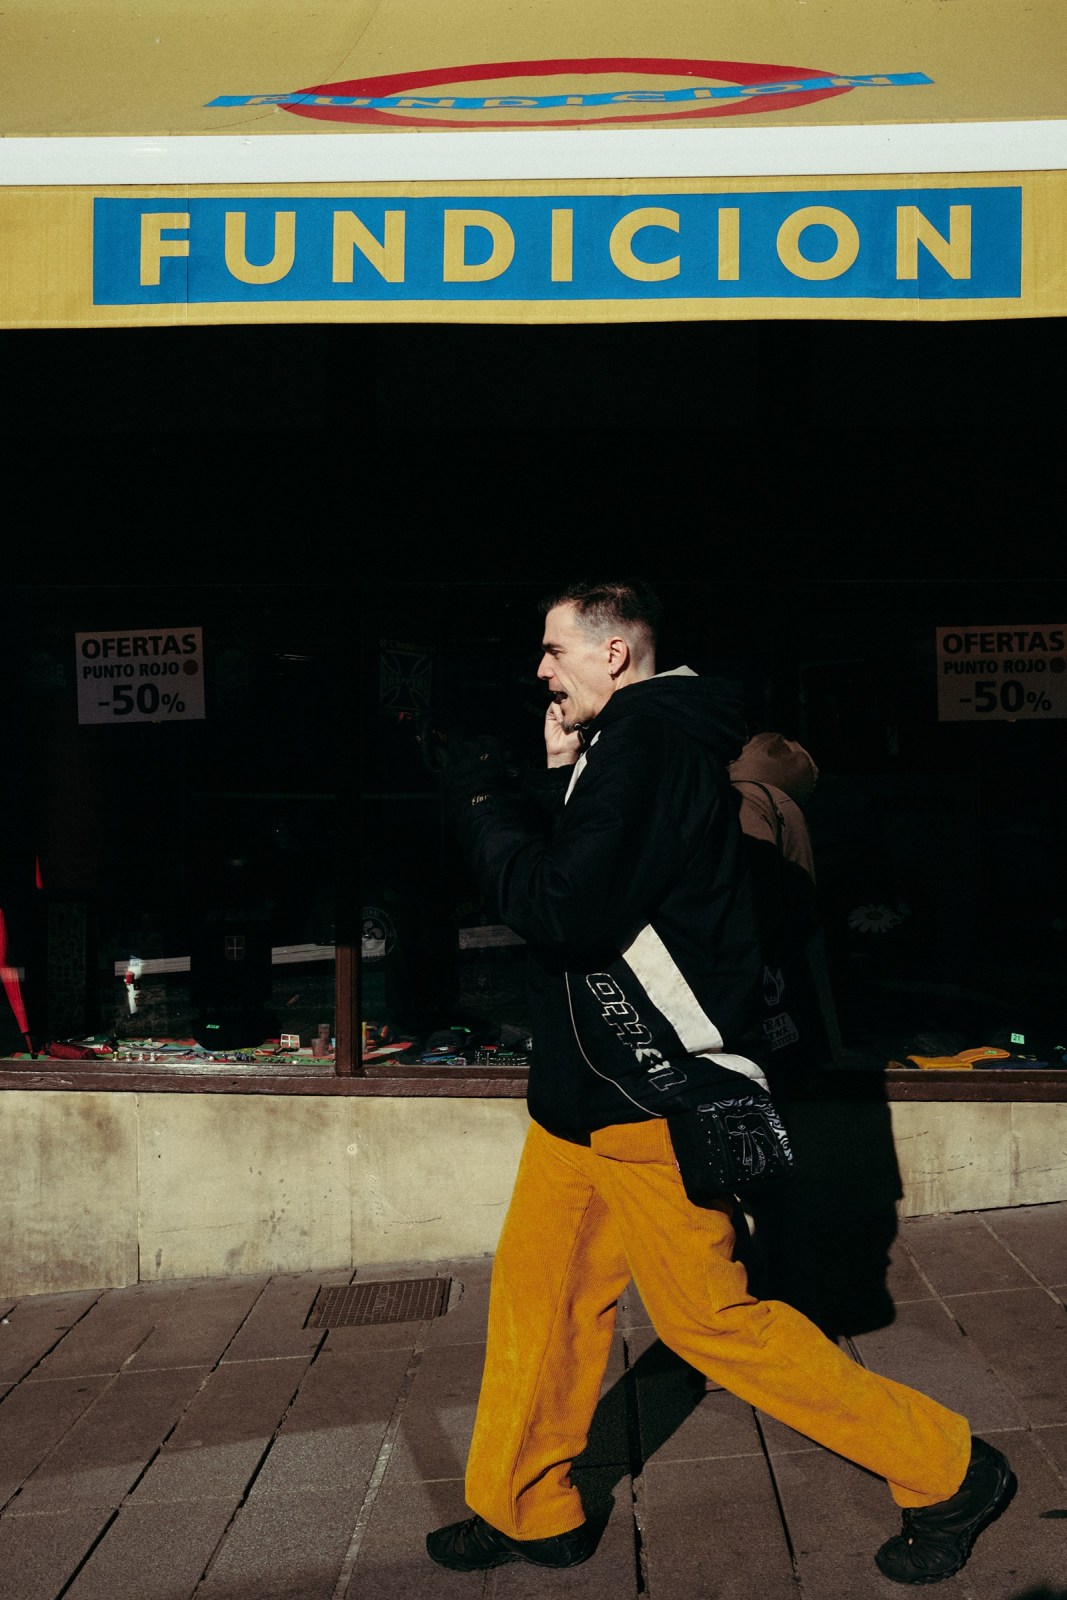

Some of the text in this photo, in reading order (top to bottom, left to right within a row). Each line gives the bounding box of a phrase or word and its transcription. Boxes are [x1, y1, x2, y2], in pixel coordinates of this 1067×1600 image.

[244, 76, 892, 107] FUNDICION
[138, 204, 973, 287] FUNDICION
[81, 634, 197, 659] OFERTAS
[943, 631, 1065, 654] OFERTAS
[83, 664, 134, 679] PUNTO
[139, 661, 180, 677] ROJO
[944, 659, 1046, 675] PUNTO ROJO
[98, 683, 186, 715] -50%
[960, 680, 1052, 713] -50%
